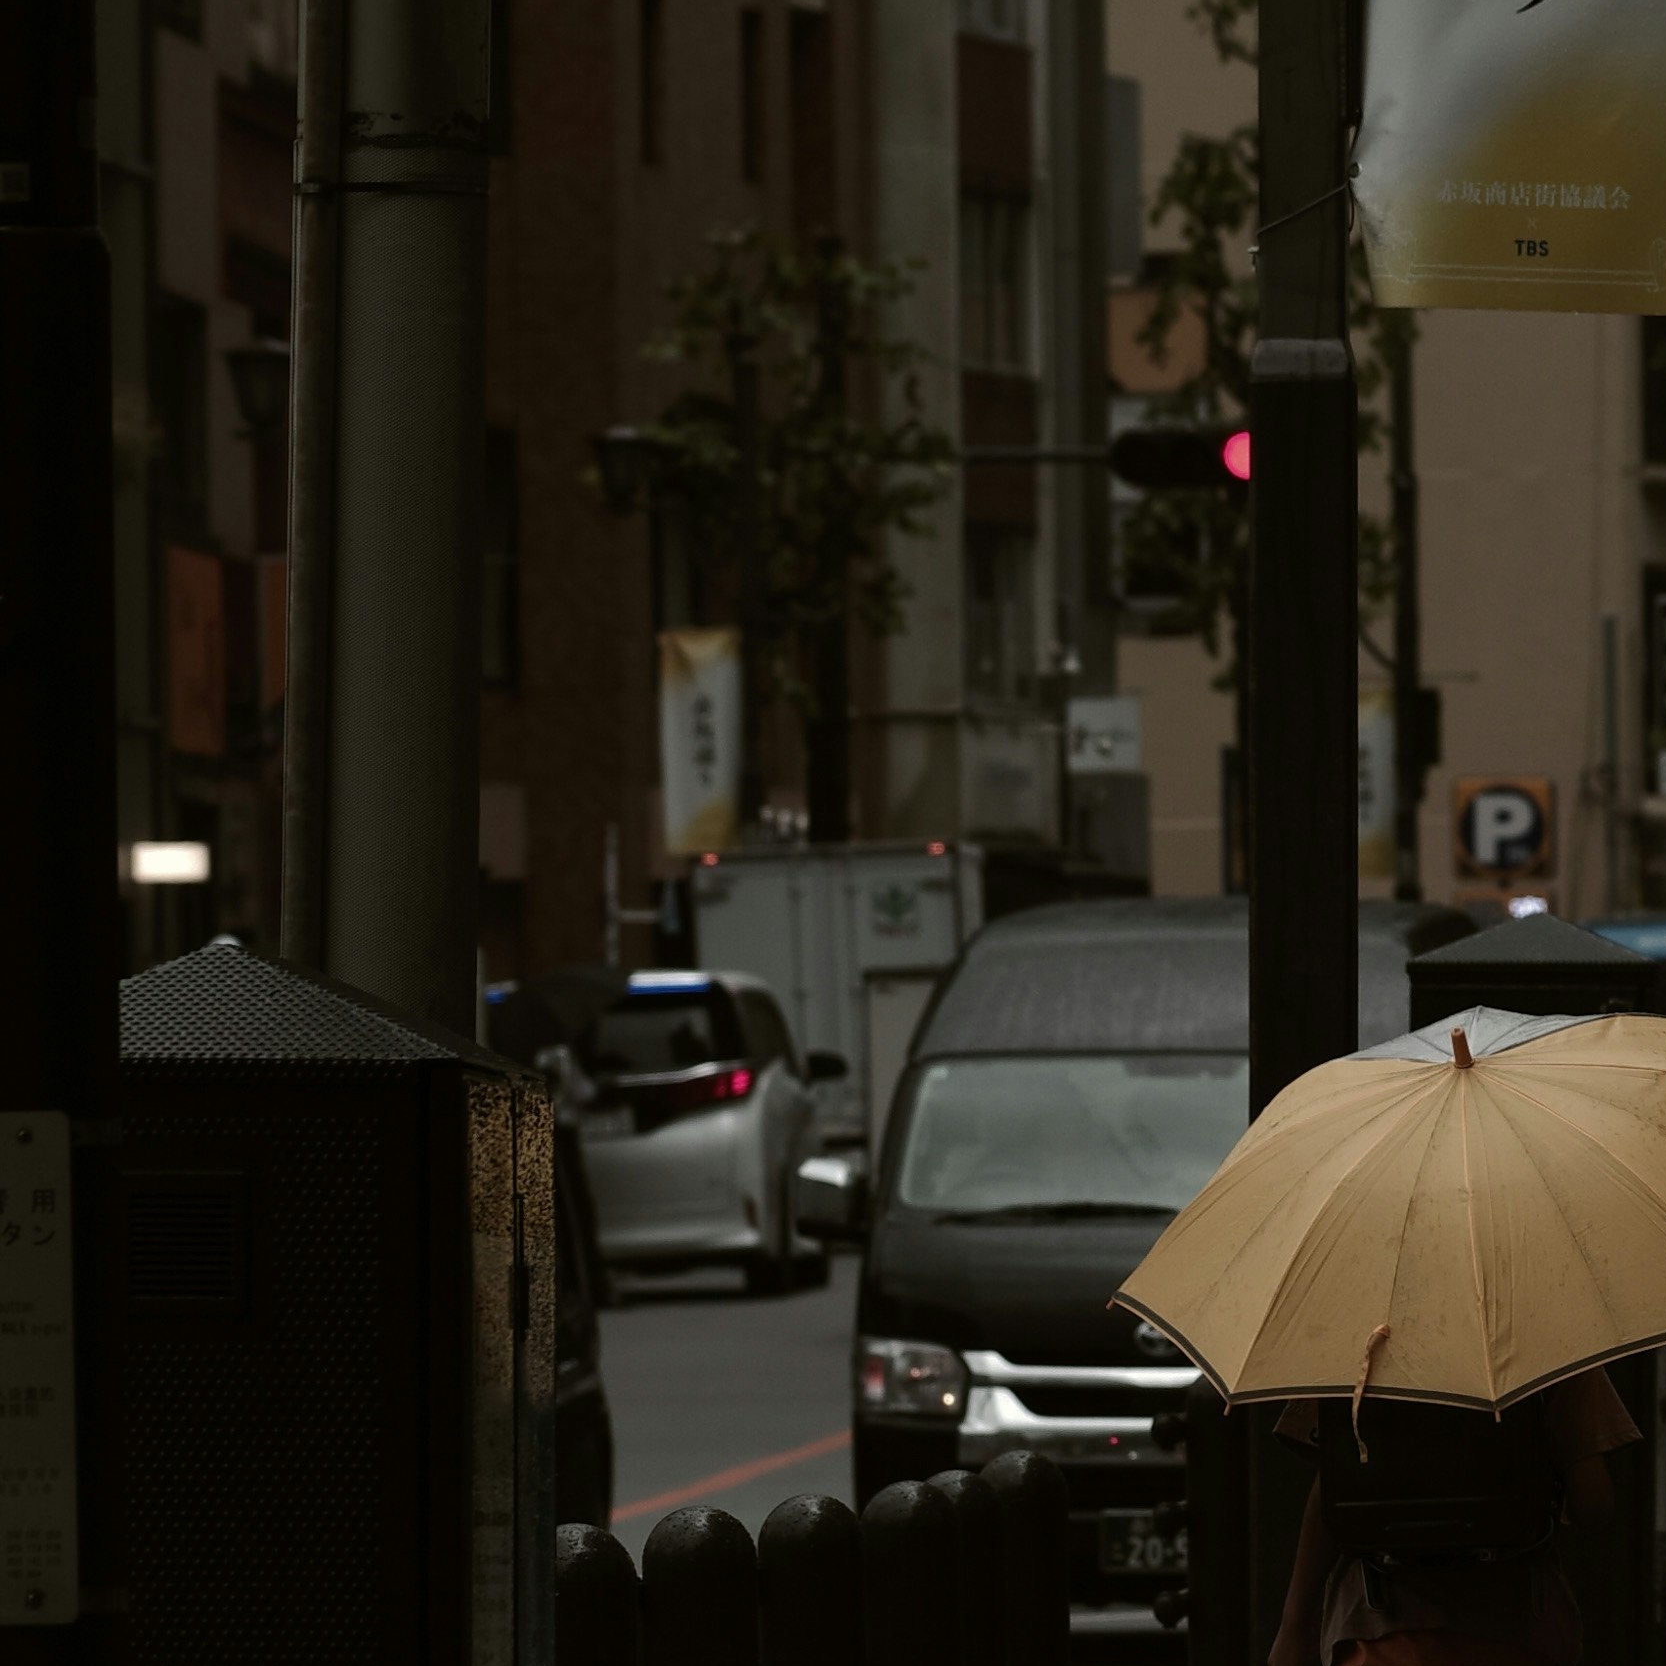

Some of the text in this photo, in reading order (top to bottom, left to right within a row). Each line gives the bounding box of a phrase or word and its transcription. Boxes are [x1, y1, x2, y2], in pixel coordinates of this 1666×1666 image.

[1437, 181, 1631, 210] 赤坂商店街協議会
[1514, 239, 1550, 257] TBS
[1473, 793, 1535, 865] P
